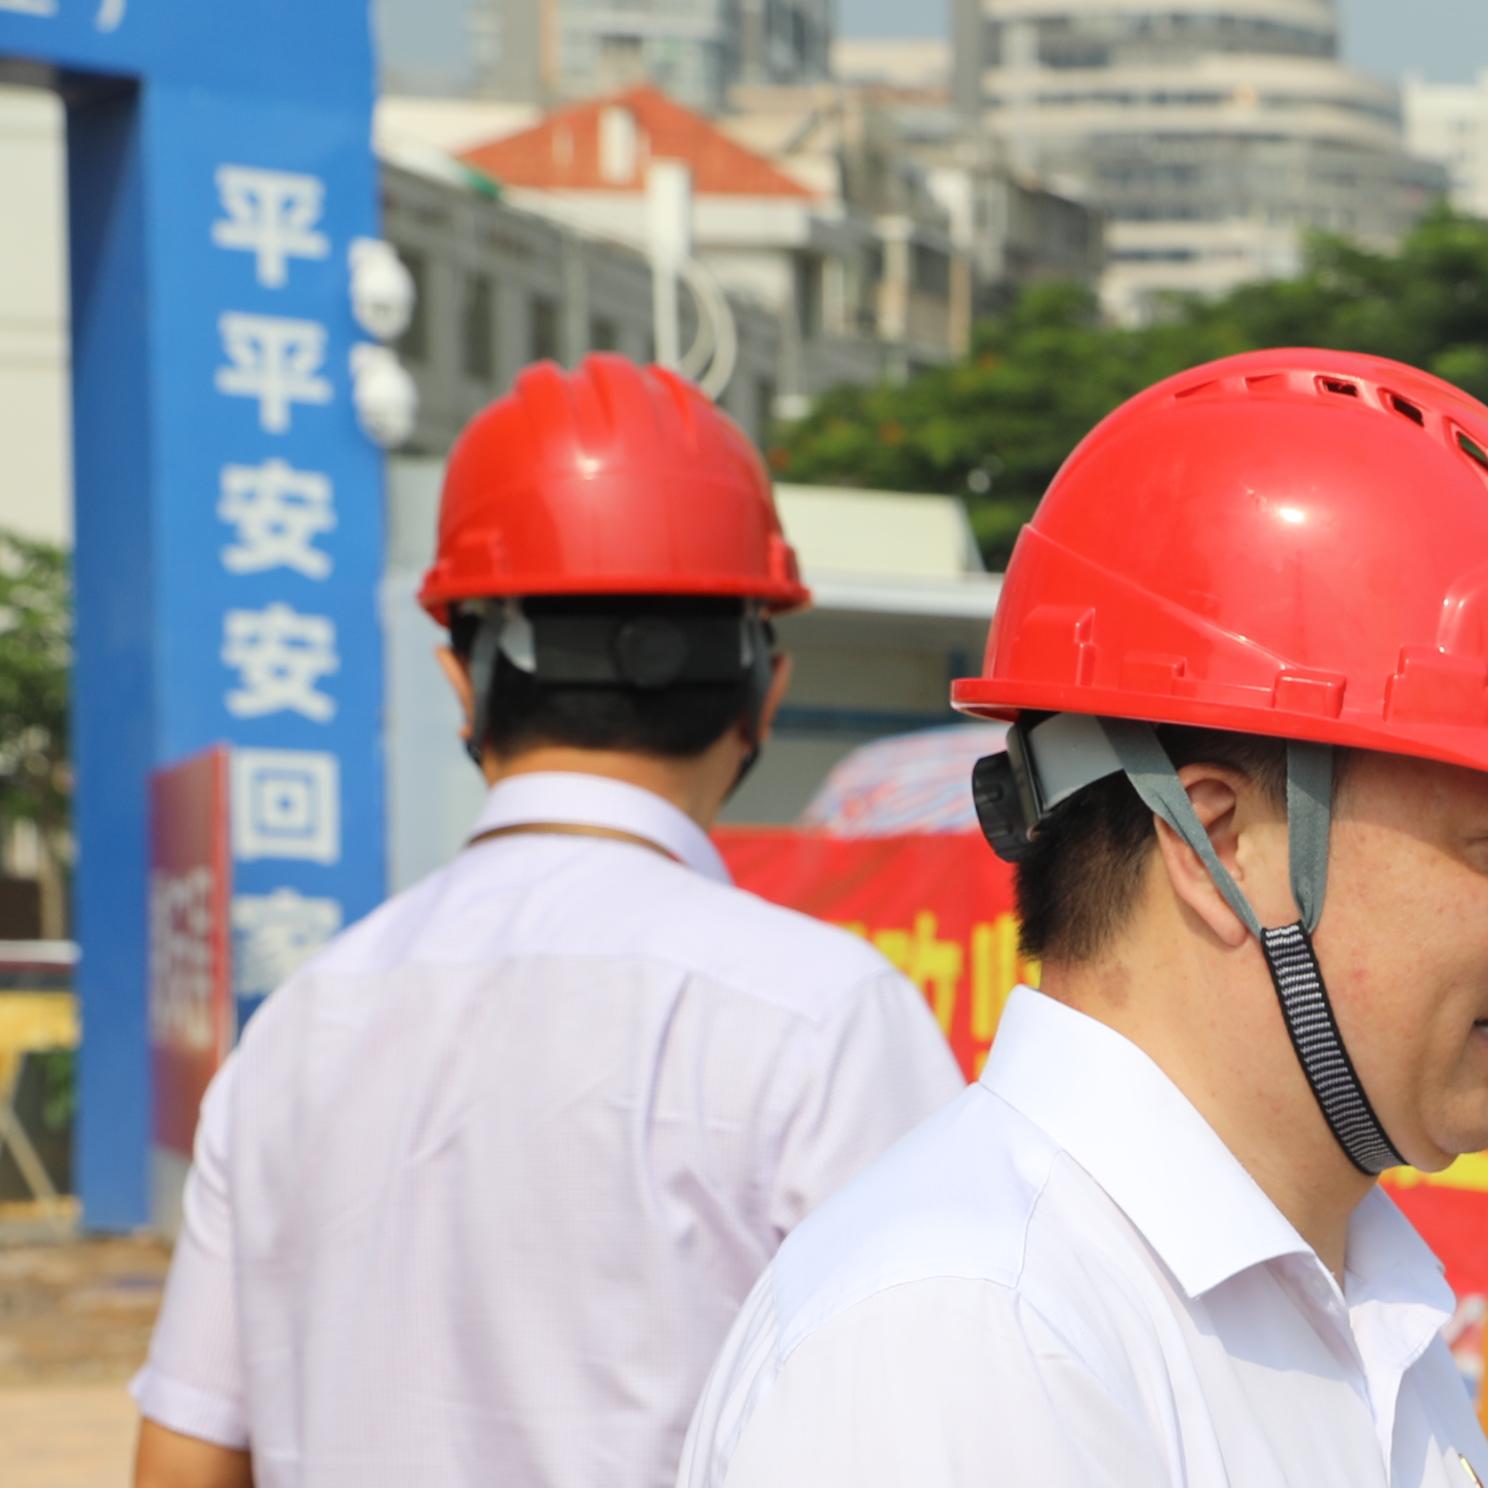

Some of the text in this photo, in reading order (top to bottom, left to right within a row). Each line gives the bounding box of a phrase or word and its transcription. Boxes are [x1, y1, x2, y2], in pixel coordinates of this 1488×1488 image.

[210, 163, 342, 1000] 平平安安回家
